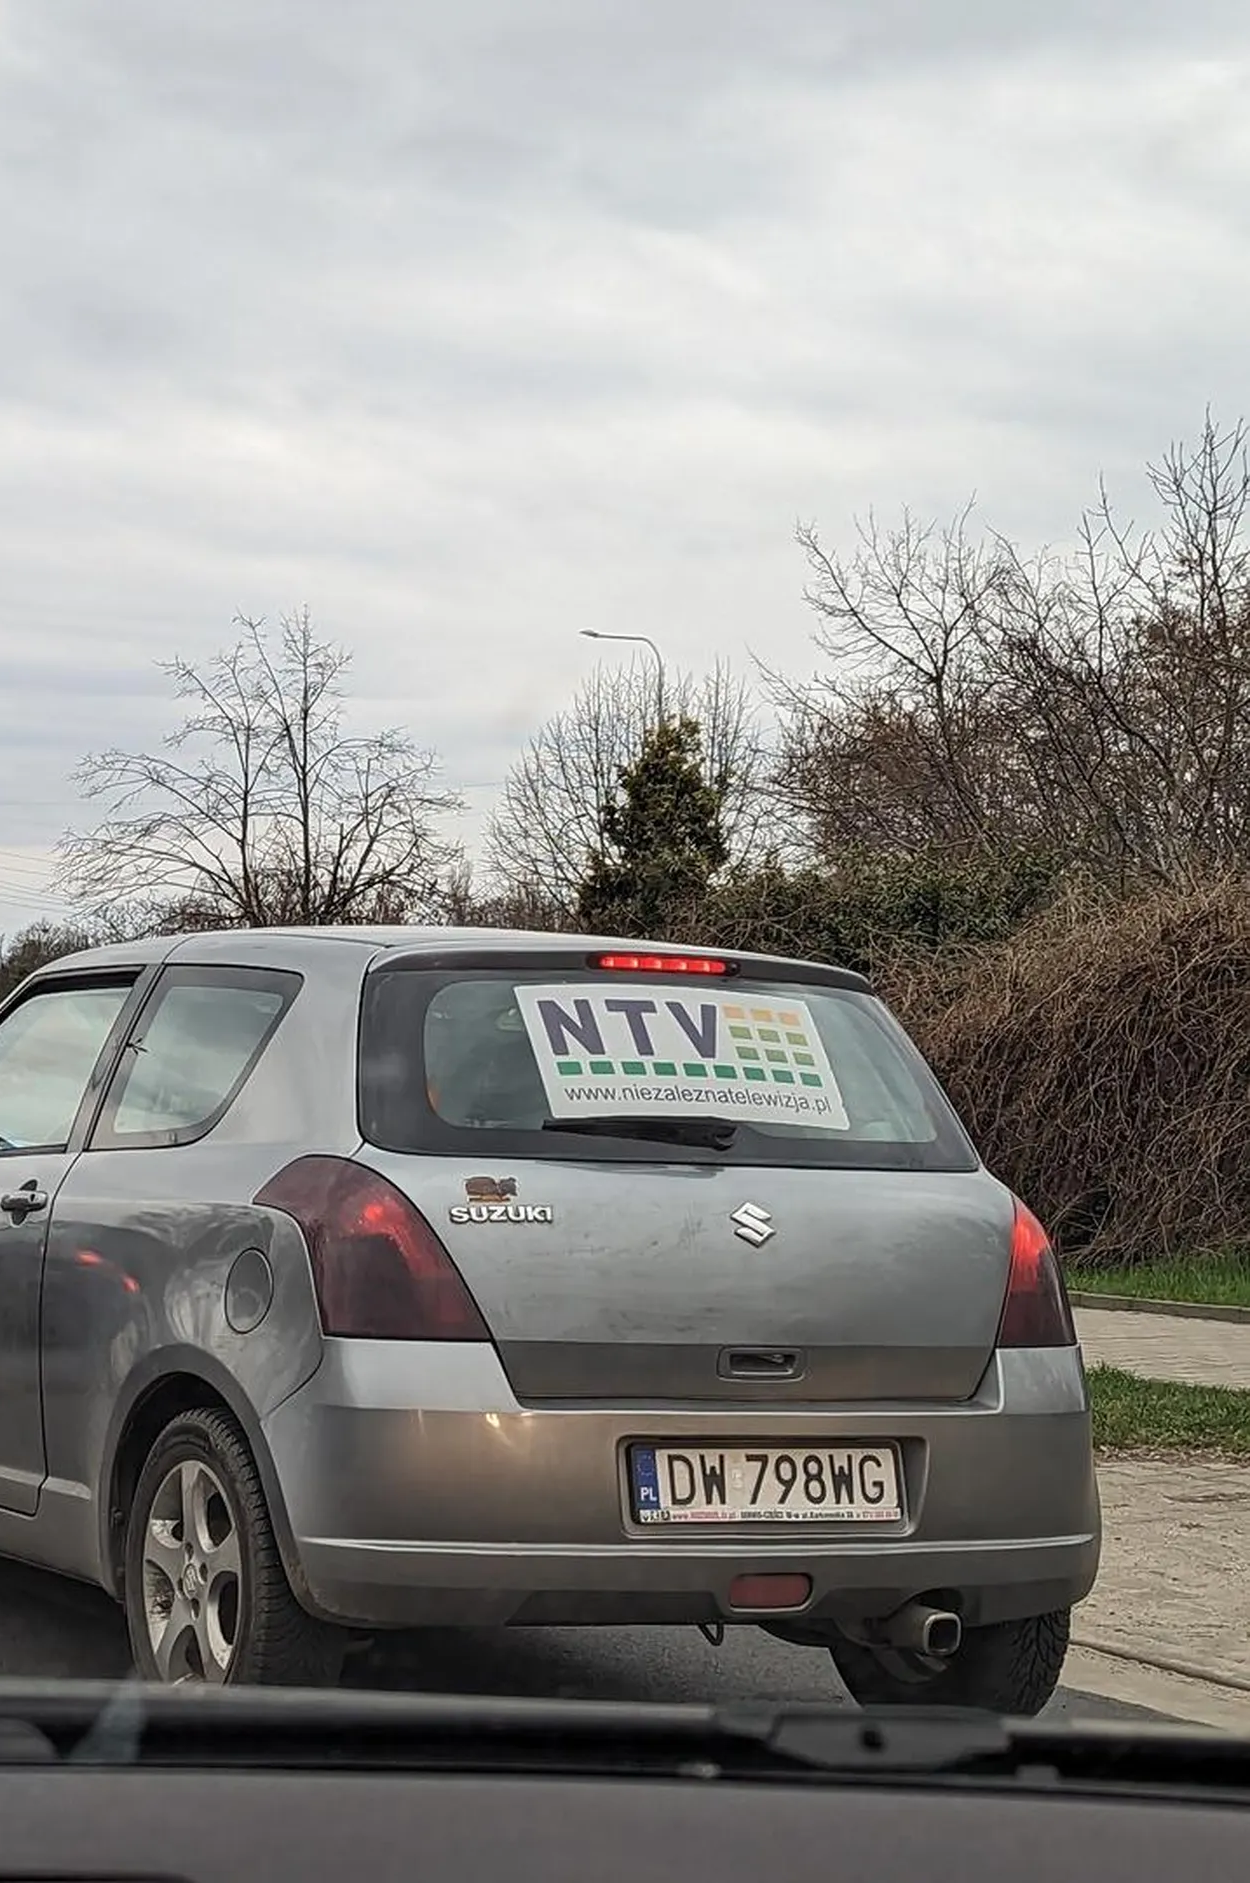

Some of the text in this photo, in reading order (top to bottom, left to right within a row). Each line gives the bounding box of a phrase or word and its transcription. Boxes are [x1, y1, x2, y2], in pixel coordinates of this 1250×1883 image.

[537, 999, 717, 1059] NTV
[564, 1083, 833, 1115] www.niezaleznatelewizja.pl
[450, 1205, 553, 1224] SUZUKI
[640, 1486, 658, 1501] PL
[667, 1453, 886, 1506] DW 798WG
